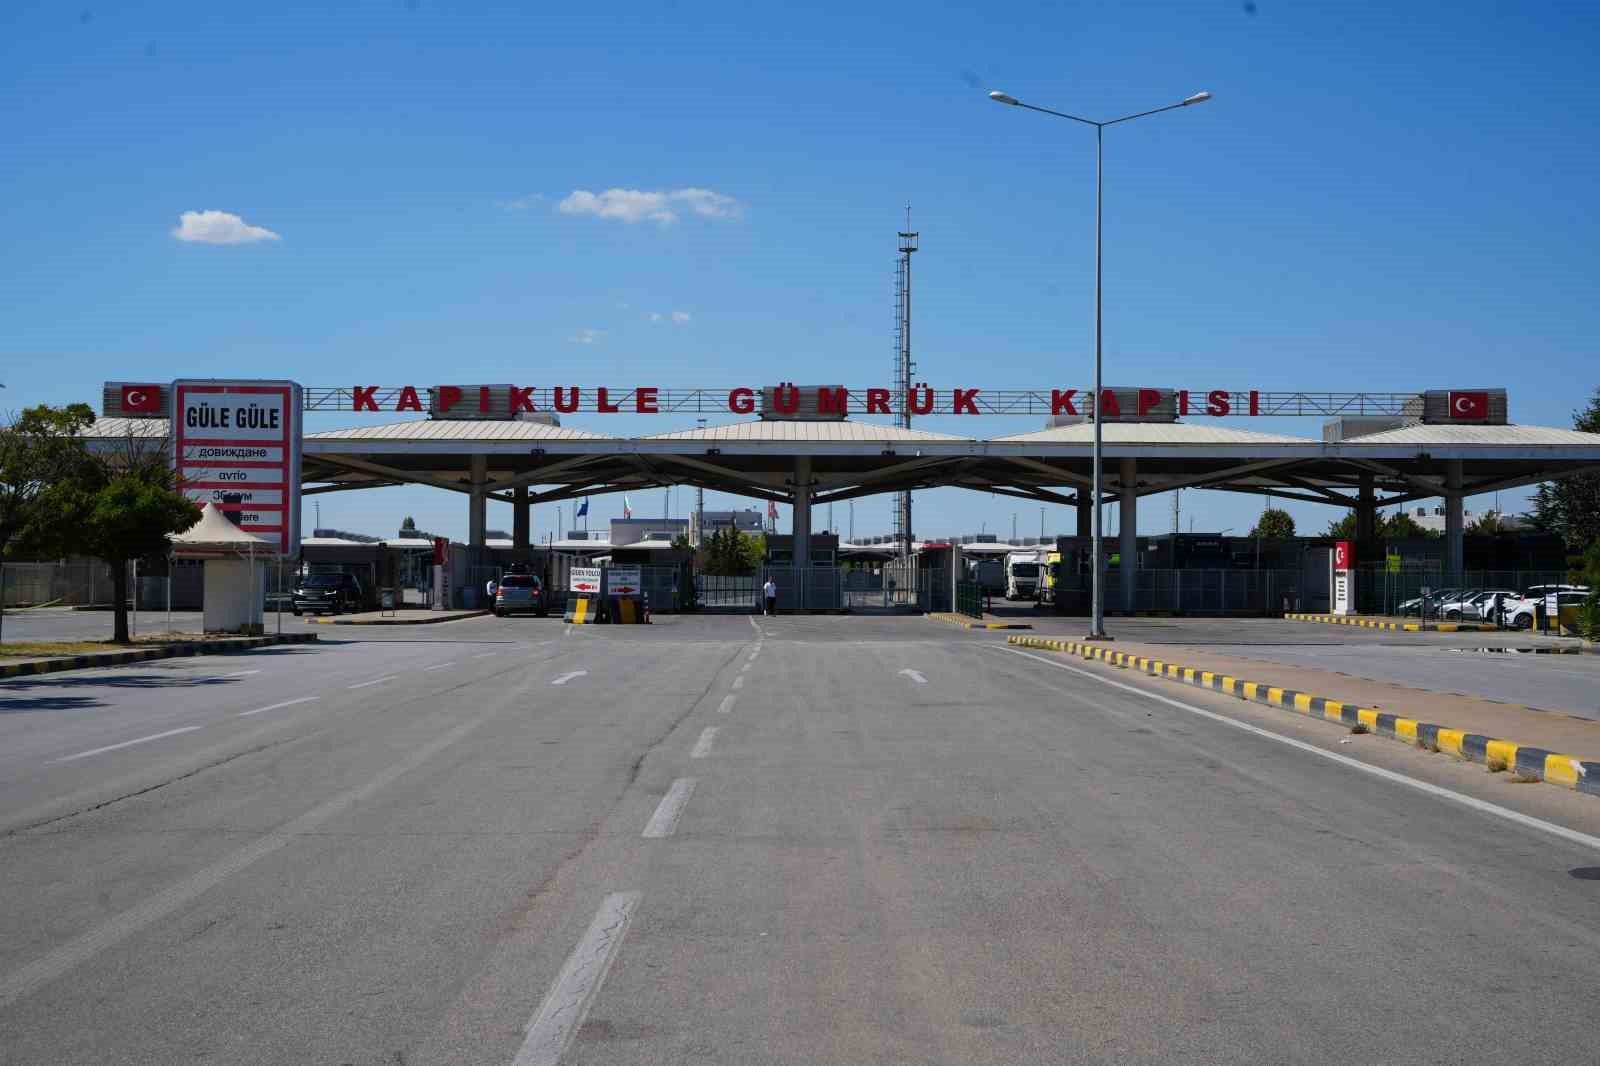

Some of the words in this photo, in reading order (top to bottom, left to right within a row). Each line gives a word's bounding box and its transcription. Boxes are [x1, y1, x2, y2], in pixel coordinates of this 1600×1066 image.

[352, 386, 659, 414] KAPIKULE
[728, 382, 981, 415] GÜMRÜK
[1051, 389, 1260, 417] KAPISI
[186, 402, 230, 428] GÜLE
[236, 403, 280, 429] GÜLE
